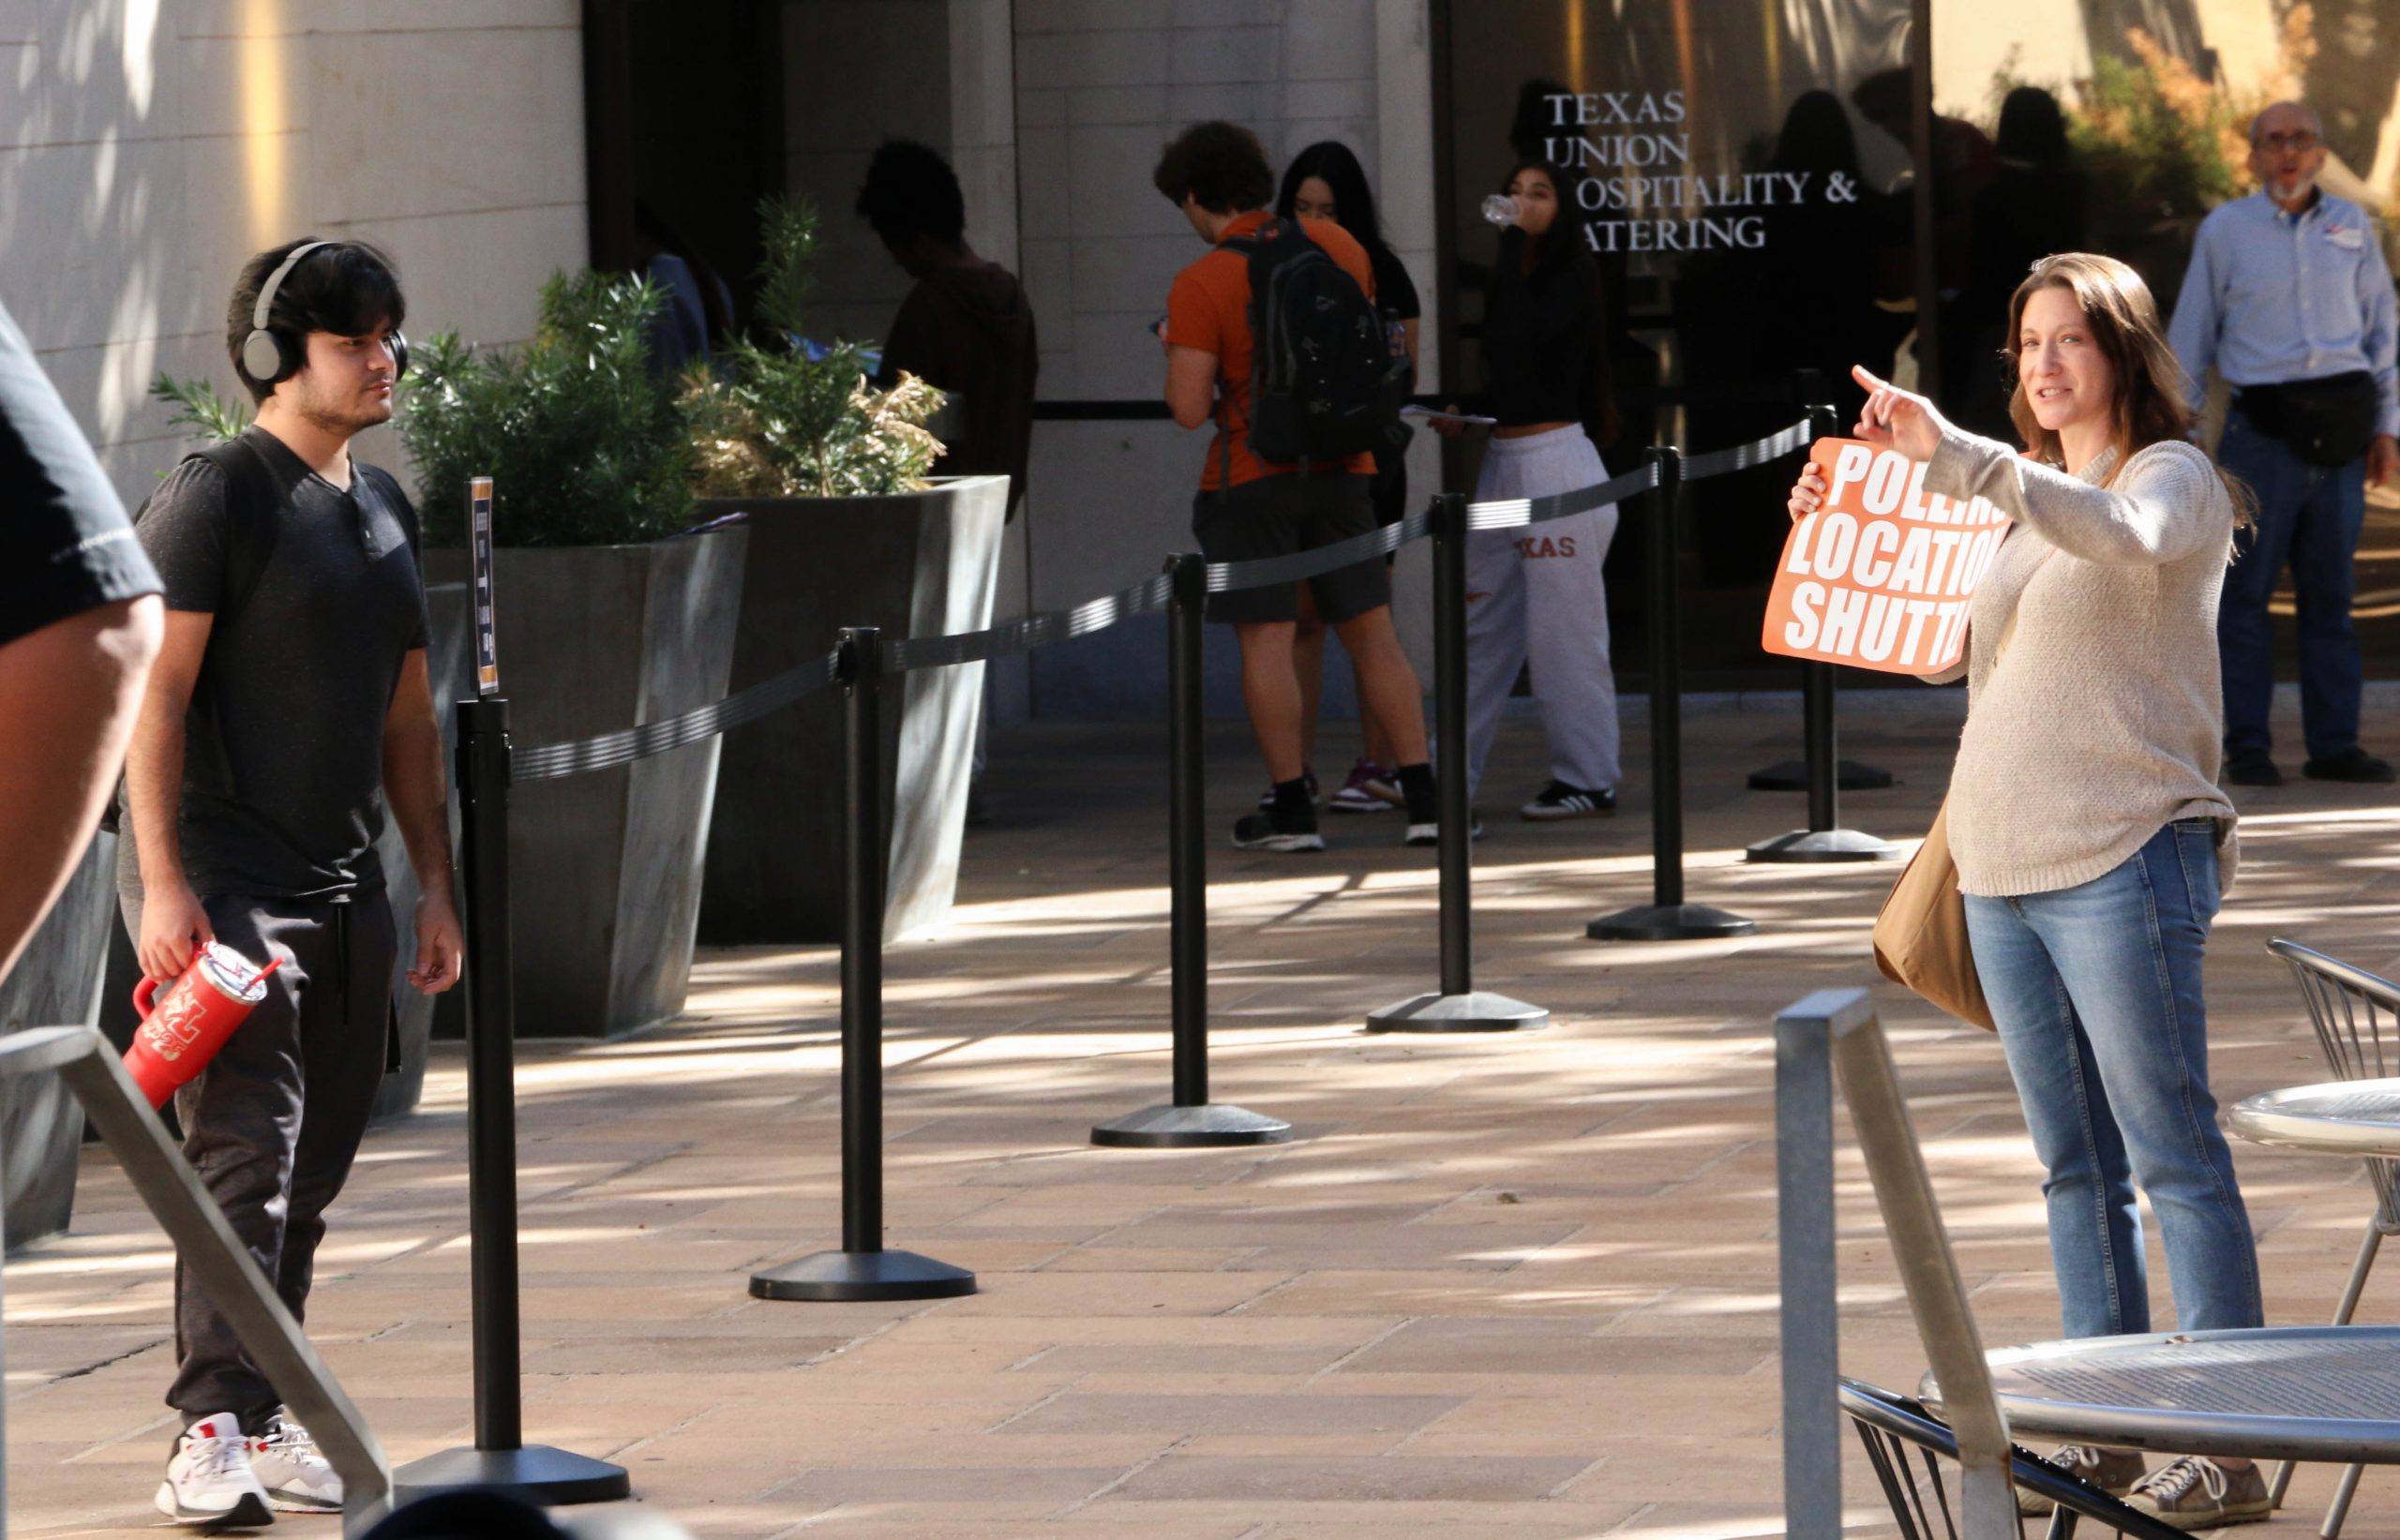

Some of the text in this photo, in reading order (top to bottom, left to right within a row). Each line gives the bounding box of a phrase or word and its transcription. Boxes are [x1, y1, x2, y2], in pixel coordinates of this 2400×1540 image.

[1543, 91, 1687, 126] TEXAS
[1545, 133, 1689, 168] UNION
[1576, 171, 1858, 210] OSPITALITY &
[1583, 216, 1765, 251] ATERING
[1827, 444, 2006, 526] POLL
[1784, 581, 1972, 666] SHUTTL
